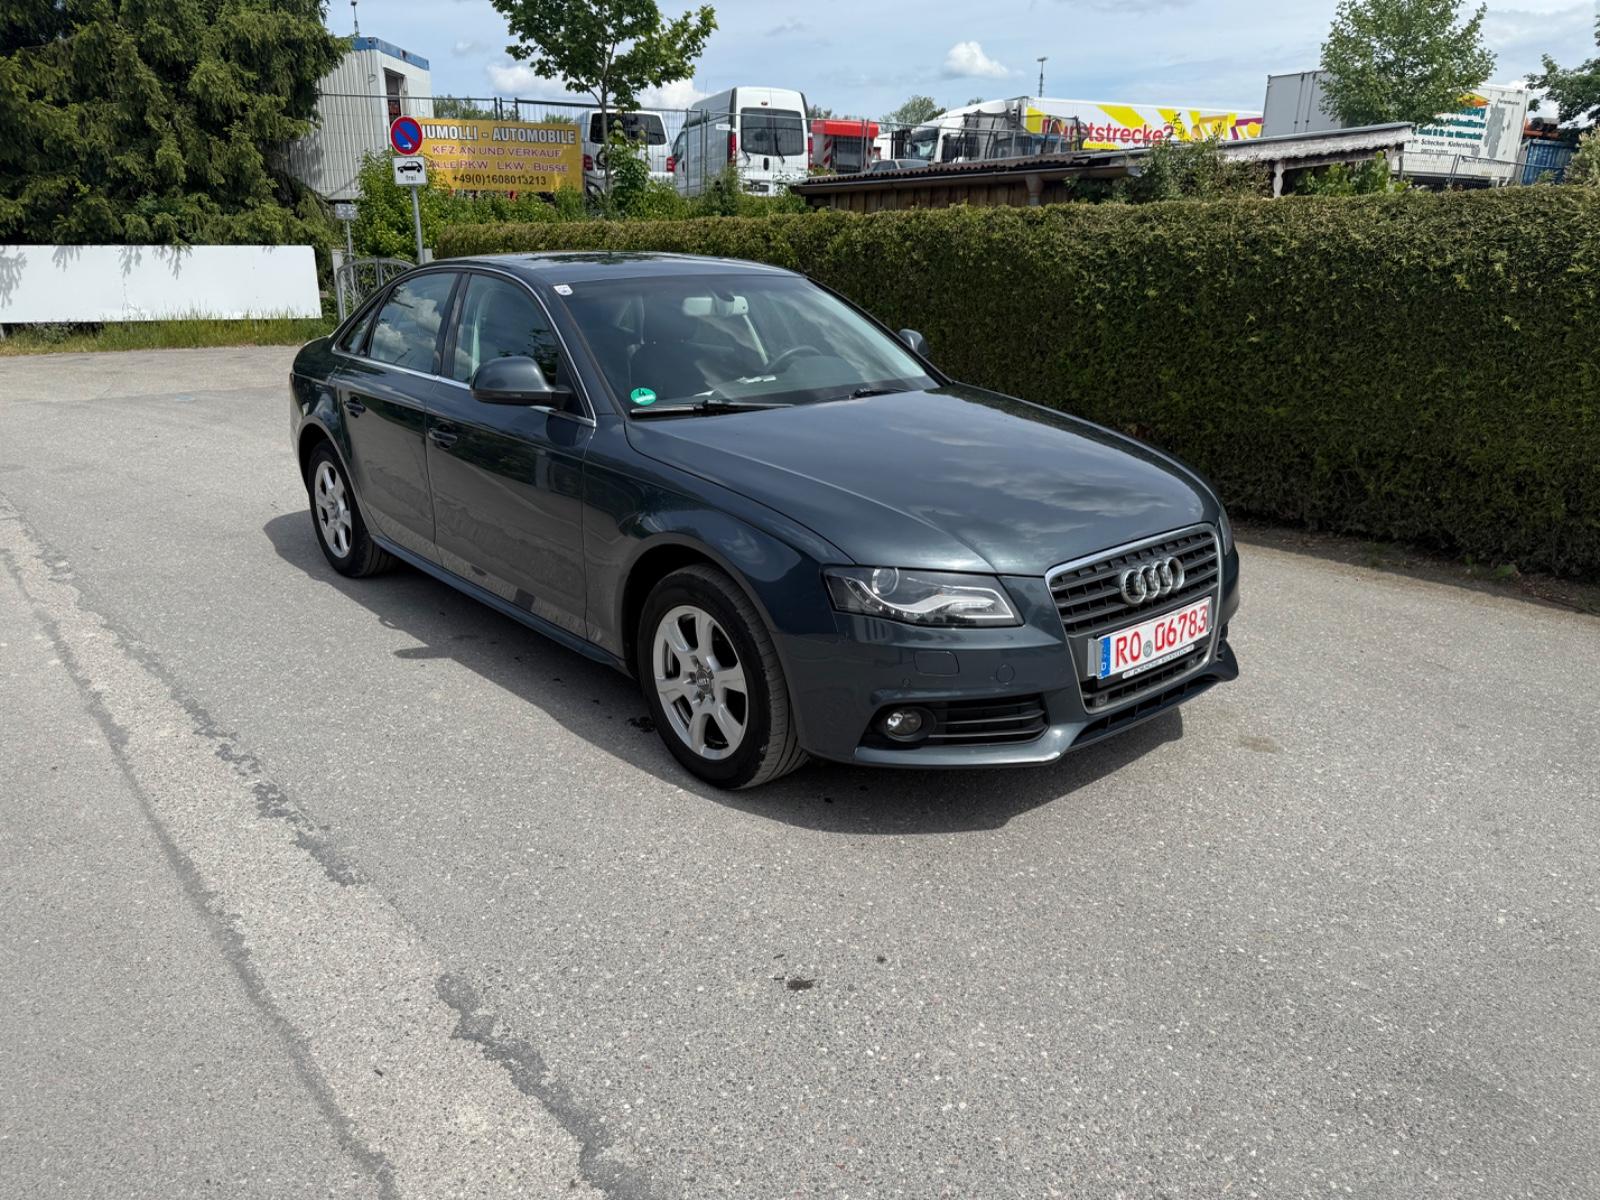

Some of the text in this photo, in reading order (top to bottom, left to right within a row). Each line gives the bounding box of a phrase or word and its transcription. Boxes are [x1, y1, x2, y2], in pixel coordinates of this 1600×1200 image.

[492, 127, 576, 144] AUTOMOBILE
[432, 145, 562, 157] KFZ AN UND VERKAUF
[460, 160, 488, 170] PKW
[496, 161, 525, 170] LKW
[1115, 631, 1141, 668] RO
[1155, 605, 1208, 652] 06783
